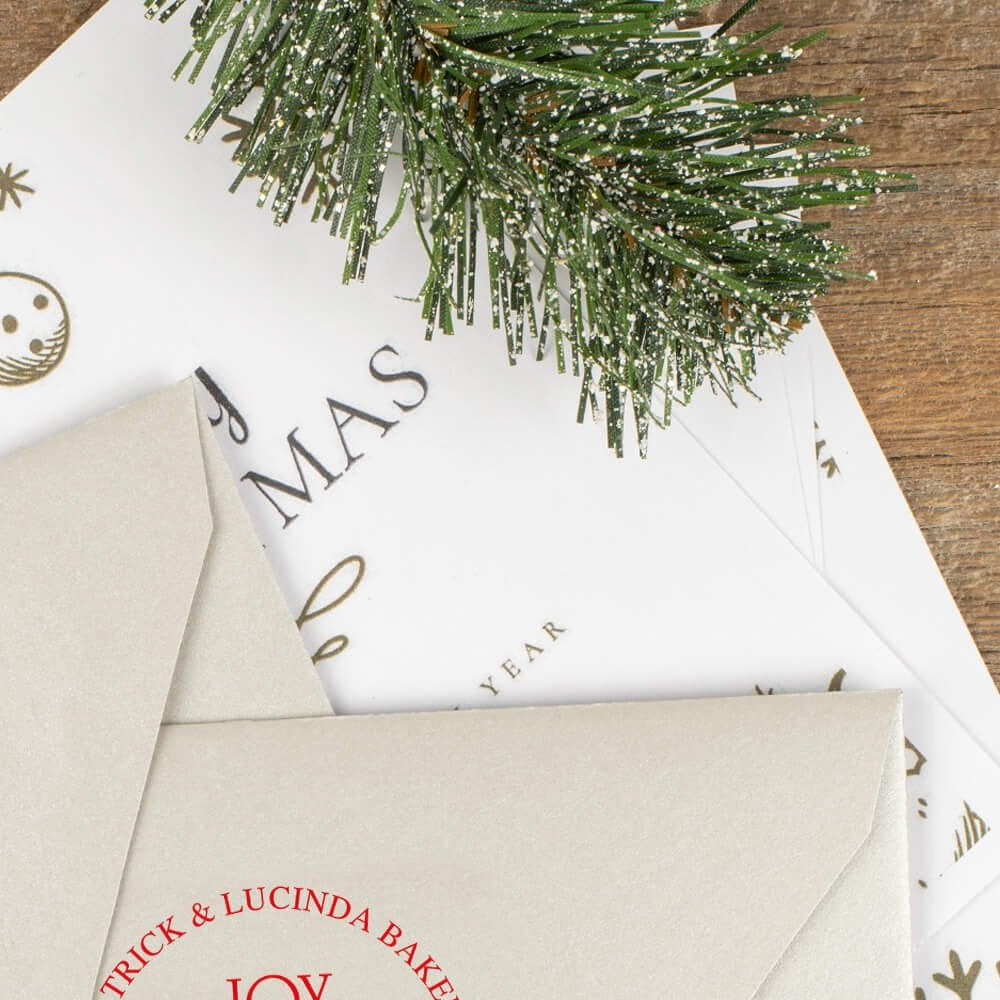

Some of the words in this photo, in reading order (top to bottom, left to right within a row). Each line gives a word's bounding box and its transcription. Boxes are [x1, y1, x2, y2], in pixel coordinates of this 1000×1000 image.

[239, 344, 429, 530] MAS
[479, 621, 567, 697] YEAR
[191, 901, 216, 929] &
[220, 884, 370, 934] LUCINDA
